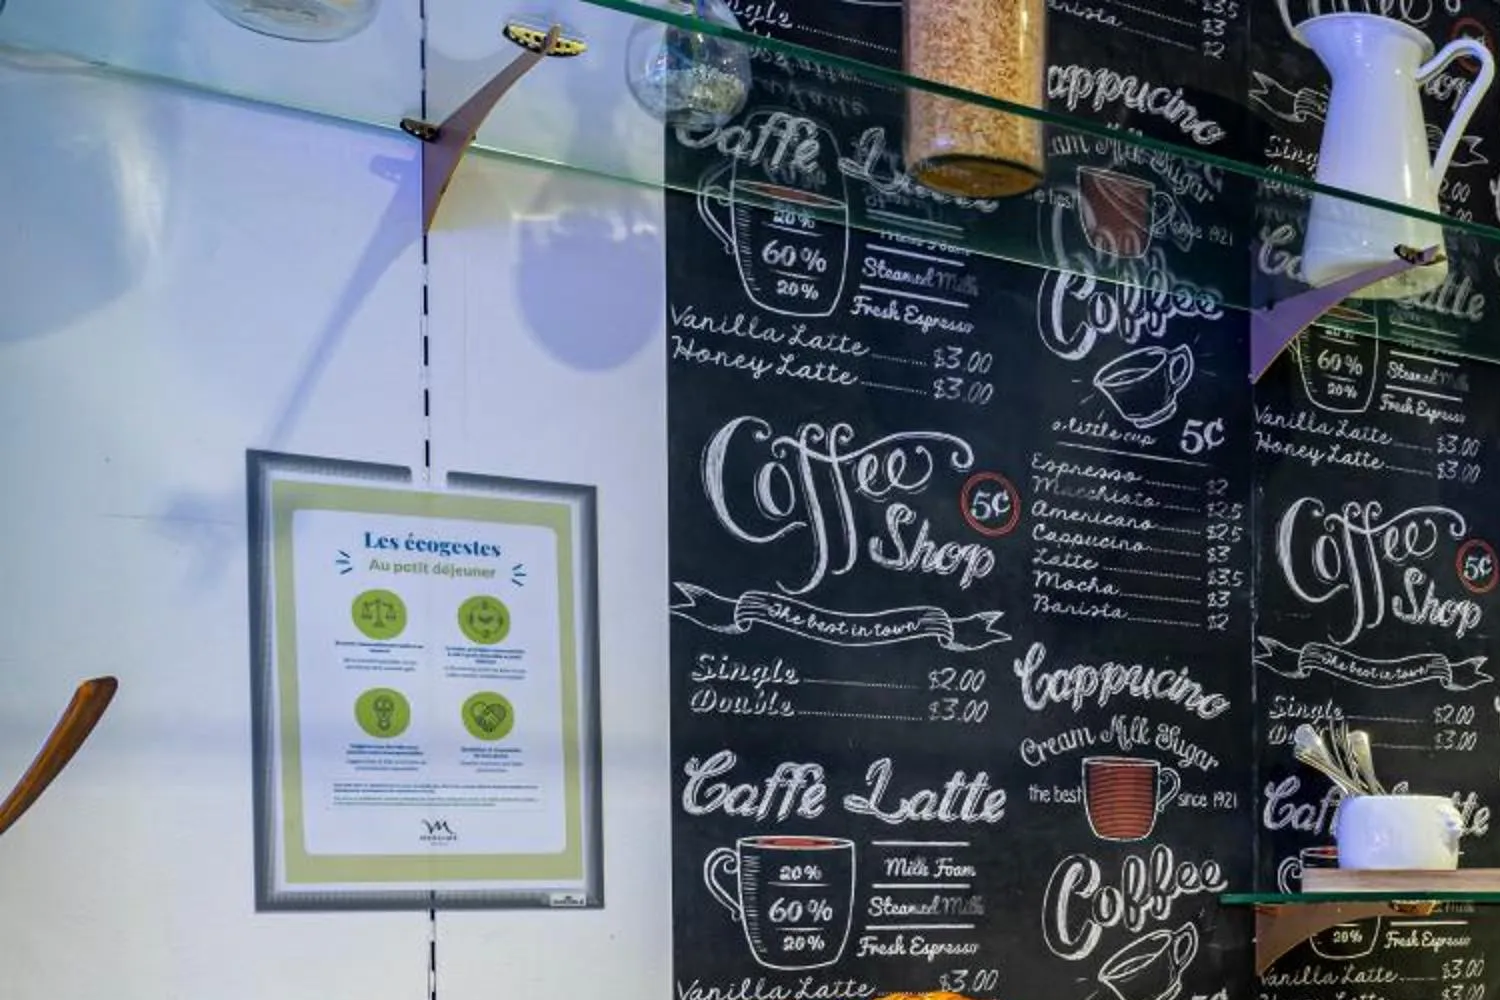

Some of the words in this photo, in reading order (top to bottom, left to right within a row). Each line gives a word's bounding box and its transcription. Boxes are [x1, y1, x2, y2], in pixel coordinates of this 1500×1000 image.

[1048, 65, 1226, 145] appucino
[850, 296, 900, 321] Fresh
[671, 305, 789, 344] Vanilla
[788, 323, 870, 357] Latte
[671, 336, 778, 380] Honey
[776, 353, 858, 386] Latte
[1179, 418, 1225, 455] 5¢
[1254, 405, 1335, 437] Vanilla
[1335, 419, 1392, 446] Latte
[1031, 453, 1144, 484] Espresso
[1254, 431, 1326, 466] Honey
[1324, 446, 1385, 470] Latte
[701, 416, 974, 593] Coffee
[1031, 499, 1158, 529] Americano
[365, 532, 398, 549] Les
[405, 532, 501, 557] écogestes
[869, 503, 995, 589] Shop
[1031, 523, 1153, 554] Cappucino
[369, 560, 391, 571] Au
[394, 562, 429, 574] petit
[432, 563, 496, 578] déjeuner
[1031, 548, 1099, 571] Latte
[1276, 497, 1466, 646] Coffee
[1032, 570, 1120, 596] Mocha
[768, 600, 805, 625] The
[807, 610, 848, 636] best
[872, 617, 921, 637] town
[1031, 593, 1128, 621] Barista
[1393, 567, 1482, 638] Shop
[691, 654, 799, 695] Single
[929, 668, 986, 692] $2.00
[1013, 642, 1230, 720] Cappucino
[929, 701, 989, 724] $3.00
[1019, 723, 1095, 765] Cream
[1100, 713, 1151, 749] Milk
[1154, 721, 1220, 773] Sugar
[843, 757, 1007, 825] Latte
[1029, 784, 1052, 804] the
[1053, 784, 1084, 805] best
[885, 857, 931, 878] Milk
[934, 857, 977, 879] Foam
[1042, 843, 1228, 960] Coffee
[856, 936, 906, 958] Fresh
[909, 936, 978, 961] Espresso
[793, 975, 876, 1000] Latte
[938, 969, 999, 993] $3.00
